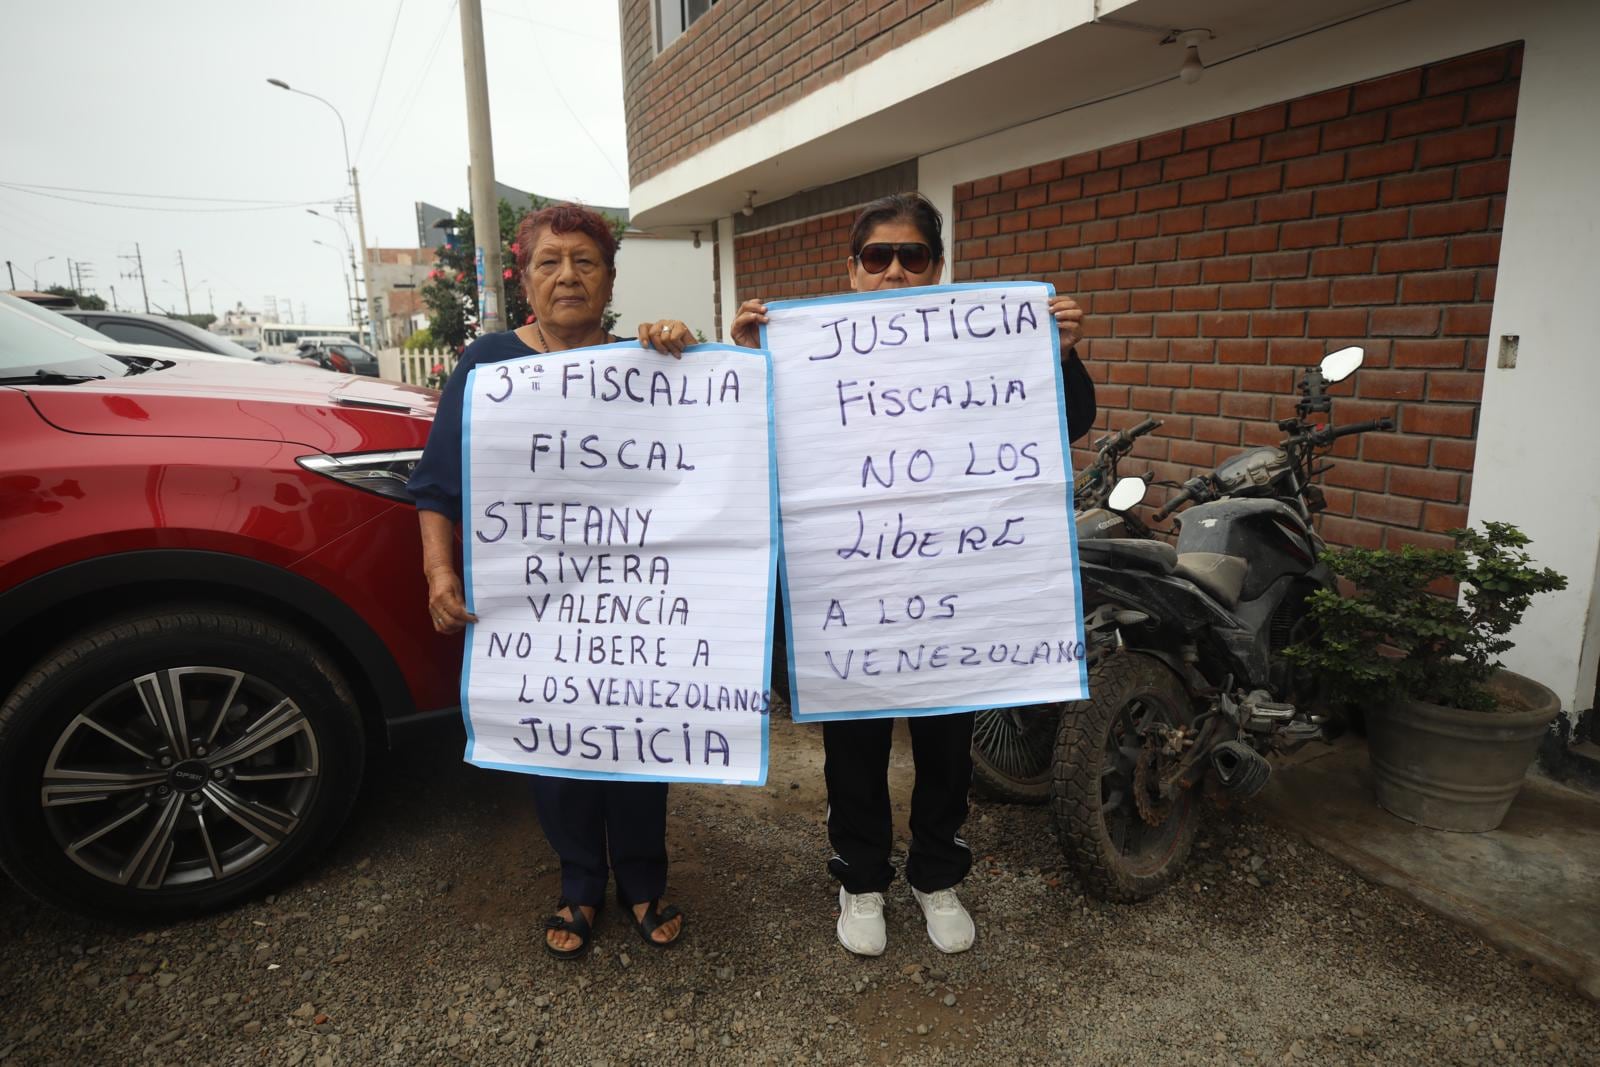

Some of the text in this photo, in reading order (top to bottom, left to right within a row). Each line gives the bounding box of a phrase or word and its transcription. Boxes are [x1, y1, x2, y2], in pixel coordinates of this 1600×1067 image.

[530, 430, 695, 472] FISCAL
[862, 442, 1041, 488] NO LOS
[476, 501, 652, 547] STEFANY
[526, 552, 669, 585] RIVERA
[823, 595, 958, 630] A LOS
[488, 632, 532, 659] NO
[692, 639, 710, 667] A
[824, 640, 1086, 681] VENEZOLANO
